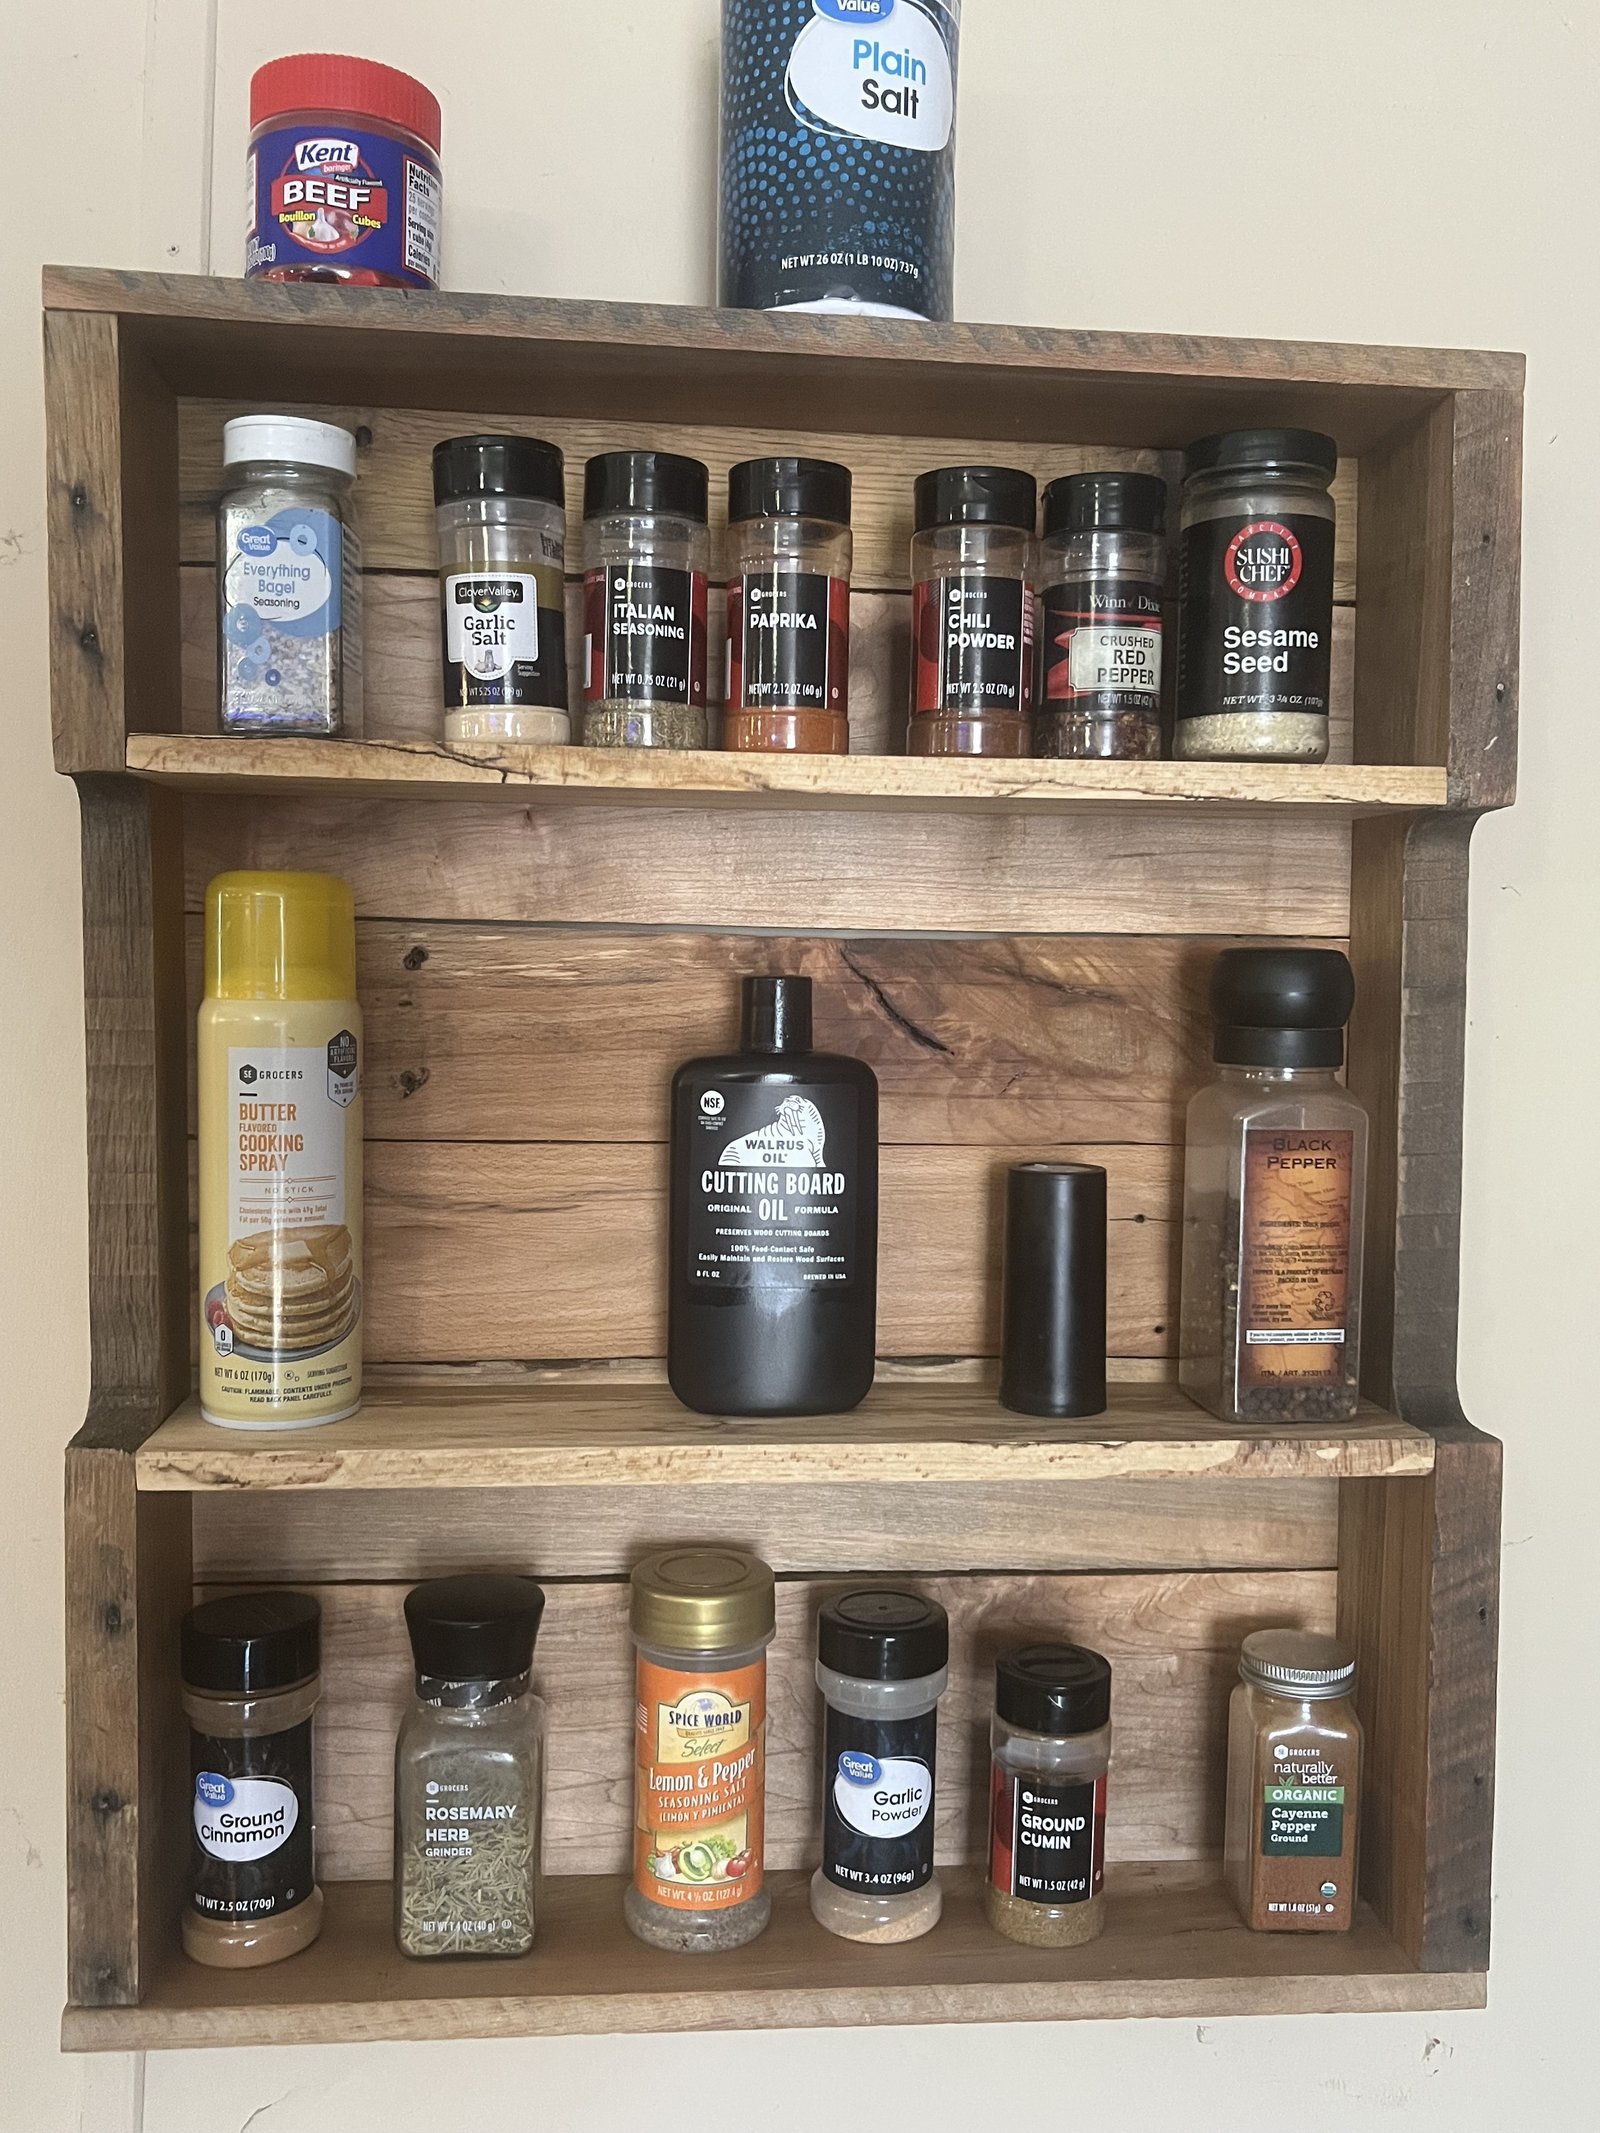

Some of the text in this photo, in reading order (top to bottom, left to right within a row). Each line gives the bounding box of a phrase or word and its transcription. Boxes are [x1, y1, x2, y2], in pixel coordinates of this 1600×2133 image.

[853, 39, 927, 86] Plain
[861, 78, 919, 119] Salt
[300, 144, 353, 165] Kent
[409, 176, 430, 197] Facts
[283, 180, 371, 210] BEEF
[279, 210, 316, 223] Bouillon
[353, 215, 381, 229] Cubes
[408, 244, 431, 267] Calories
[781, 252, 919, 278] NET WT 26 OZ (1 LB 10 OZ) 737g
[241, 532, 271, 544] Great
[248, 543, 271, 551] Value
[1236, 547, 1289, 566] SUSHI
[243, 561, 311, 581] Everything
[1239, 565, 1287, 583] CHEF
[258, 579, 295, 597] Bagel
[1230, 578, 1296, 600] COMPANY
[253, 596, 300, 610] Seasoning
[1090, 594, 1126, 609] Winn
[613, 603, 675, 622] ITALIAN
[464, 614, 516, 631] Garlic
[750, 612, 817, 630] PAPRIKA
[948, 613, 991, 629] CHILI
[471, 630, 507, 646] Salt
[612, 622, 685, 640] SEASONING
[1223, 626, 1318, 649] Sesame
[948, 633, 1015, 650] POWDER
[1100, 635, 1154, 649] CRUSHED
[1113, 649, 1146, 665] RED
[1223, 651, 1288, 674] Seed
[612, 673, 677, 688] NET WT 0.75 OZ (21
[1097, 667, 1154, 685] PEPPER
[469, 687, 478, 697] WT
[748, 683, 815, 697] NET WT 2.12 OZ (60
[946, 682, 1008, 696] NET WT 2.5 OZ (70
[1110, 694, 1121, 704] WT
[1222, 695, 1302, 705] NET WT OZ
[339, 1036, 350, 1048] NO
[259, 1070, 303, 1080] GROCERS
[704, 1096, 721, 1109] NSF
[239, 1103, 296, 1121] BUTTER
[239, 1123, 277, 1133] FLAVORED
[239, 1134, 304, 1152] COOKING
[745, 1139, 804, 1150] WALRUS
[239, 1153, 289, 1172] SPRAY
[762, 1153, 786, 1164] OIL
[701, 1170, 845, 1195] CUTTING BOARD
[707, 1198, 839, 1221] ORIGINAL OIL FORMULA
[715, 1228, 752, 1236] PRESERVES
[803, 1229, 830, 1237] BOARDS
[730, 1244, 815, 1253] 100% Safe
[698, 1252, 718, 1263] Easily
[719, 1253, 751, 1262] Maintain
[766, 1255, 794, 1263] Restore
[795, 1255, 815, 1263] Wood
[816, 1255, 845, 1263] Surfaces
[702, 1270, 720, 1278] FL OZ
[220, 1329, 226, 1342] 0
[214, 1367, 275, 1383] NET WT 6 OZ (170g)
[283, 1385, 313, 1394] CONTENTS
[669, 1709, 743, 1727] SPICE WORLD
[681, 1738, 727, 1758] Select
[1289, 1749, 1320, 1757] GROCERS
[649, 1748, 756, 1791] Lemon & Pepper
[842, 1756, 874, 1773] Great
[1273, 1761, 1334, 1776] naturally
[849, 1768, 874, 1780] Value
[1302, 1773, 1338, 1785] better
[199, 1777, 225, 1794] Great
[439, 1784, 469, 1792] GROCERS
[658, 1777, 746, 1808] SEASONING SALT
[203, 1789, 226, 1801] Value
[873, 1787, 923, 1806] Garlic
[1033, 1797, 1058, 1805] GROCERS
[1272, 1789, 1337, 1801] ORGANIC
[425, 1805, 517, 1821] ROSEMARY
[693, 1794, 745, 1820] Y PIMIENTA)
[872, 1804, 923, 1821] Powder
[1271, 1807, 1329, 1820] Cayenne
[220, 1806, 285, 1828] Ground
[1021, 1813, 1085, 1832] GROUND
[201, 1824, 284, 1843] Cinnamon
[425, 1828, 470, 1842] HERB
[1271, 1820, 1317, 1835] Pepper
[1020, 1831, 1071, 1850] CUMIN
[1270, 1834, 1308, 1843] Ground
[425, 1847, 473, 1857] GRINDER
[835, 1864, 915, 1885] NET WT 3.4 OZ (96g)
[1019, 1874, 1078, 1892] NET WT 1.5 OZ (42
[657, 1885, 686, 1900] NET WT.
[206, 1895, 275, 1912] WT 2.5 OZ (70g)
[1278, 1903, 1305, 1912] WT OZ
[423, 1920, 487, 1932] NET WT OZ (40
